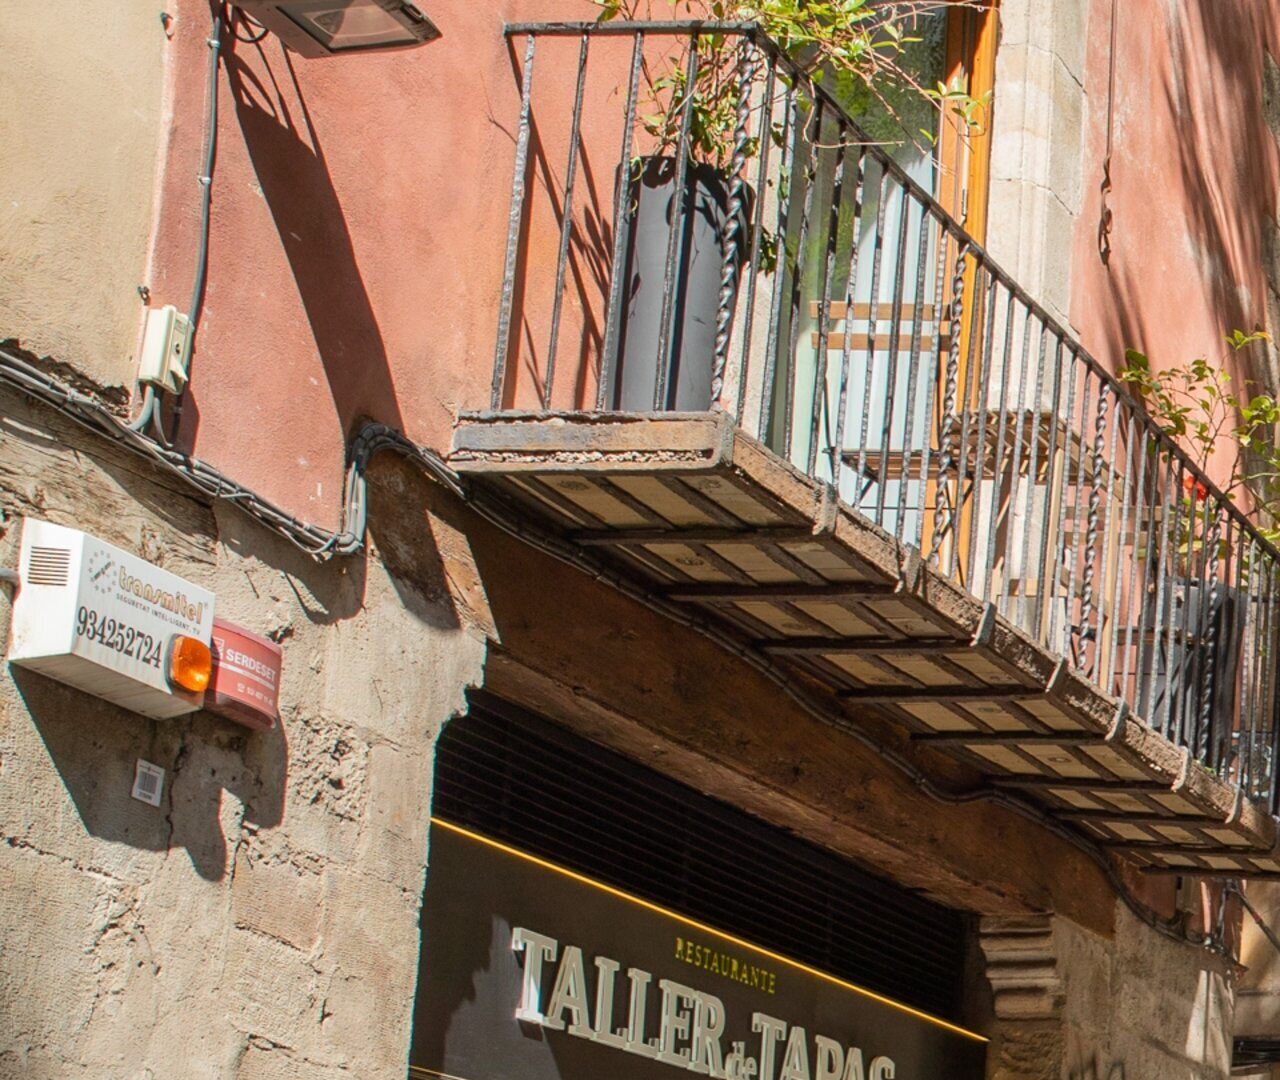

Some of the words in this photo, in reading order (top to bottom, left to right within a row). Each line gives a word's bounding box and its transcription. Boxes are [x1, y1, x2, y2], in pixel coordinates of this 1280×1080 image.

[118, 565, 204, 625] transmitel
[76, 606, 163, 669] 934252724
[675, 936, 777, 996] RESTAURANTE
[511, 926, 726, 1080] TALLER
